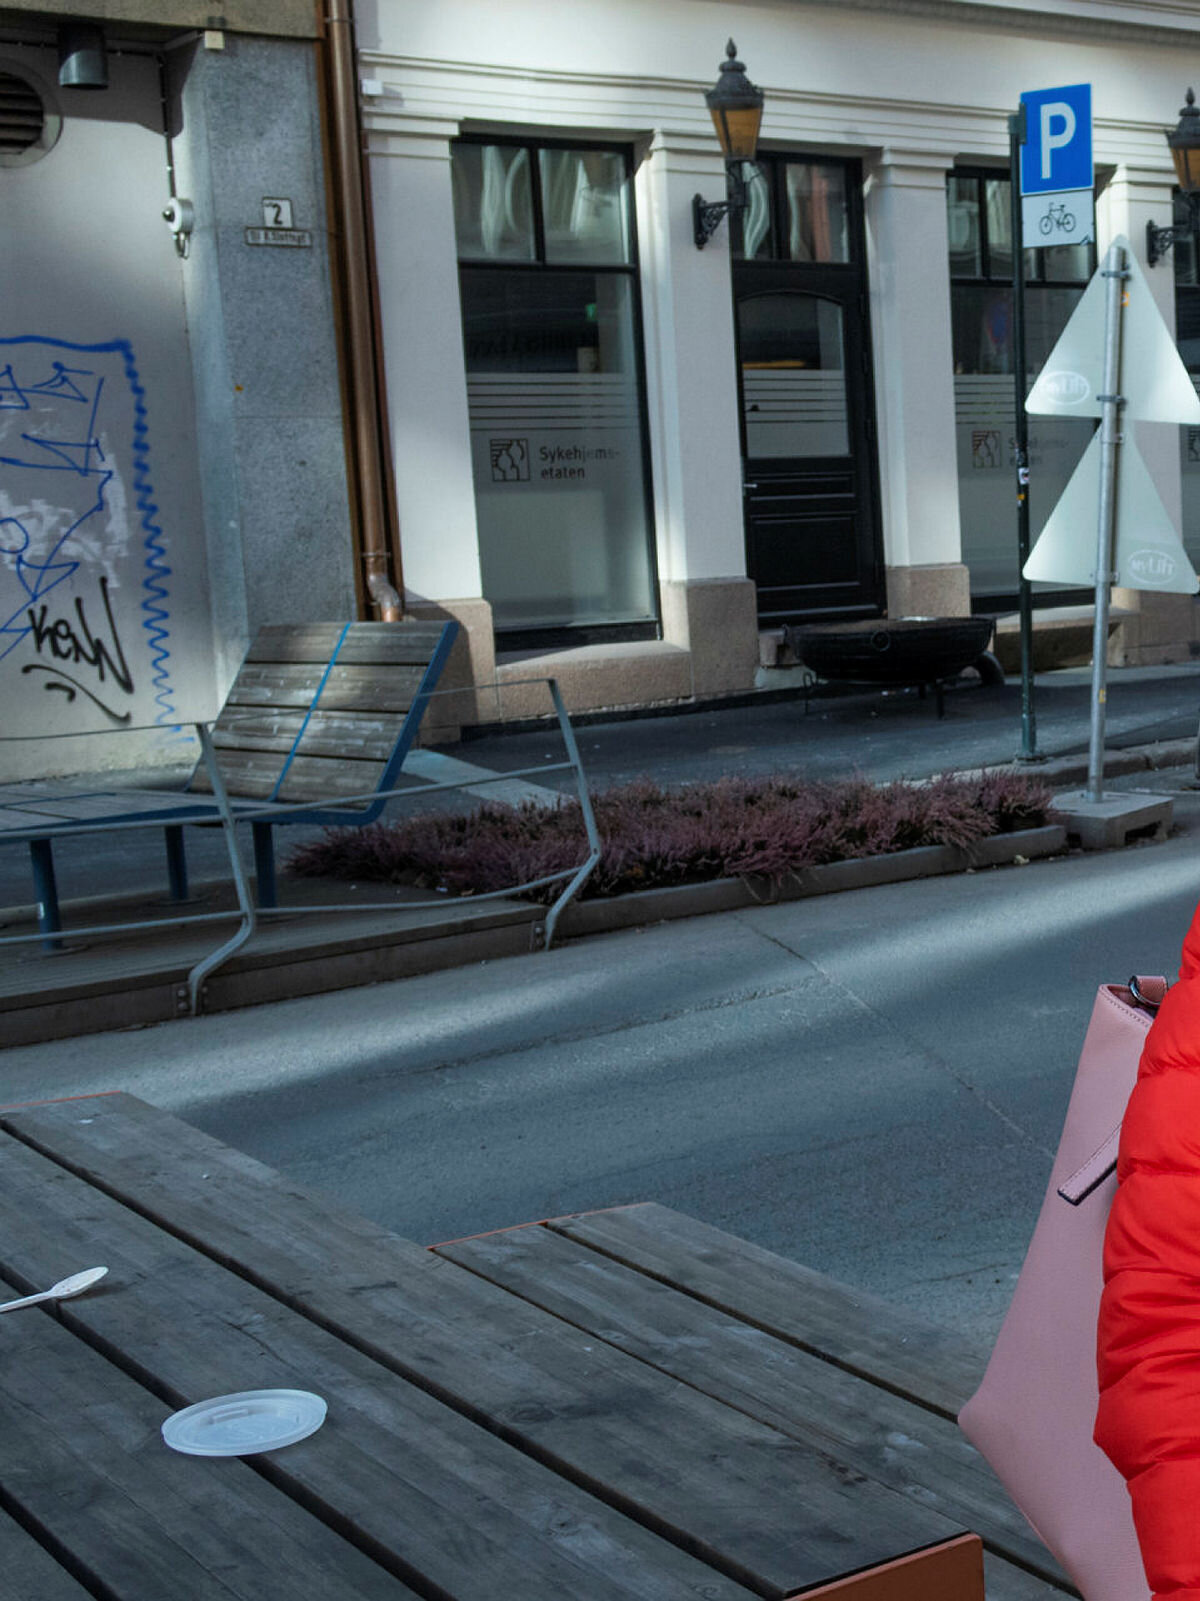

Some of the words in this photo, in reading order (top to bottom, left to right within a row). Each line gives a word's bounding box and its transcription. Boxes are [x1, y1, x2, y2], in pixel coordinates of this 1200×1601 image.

[1040, 101, 1076, 180] P
[272, 203, 283, 226] 2
[541, 467, 586, 480] etaten
